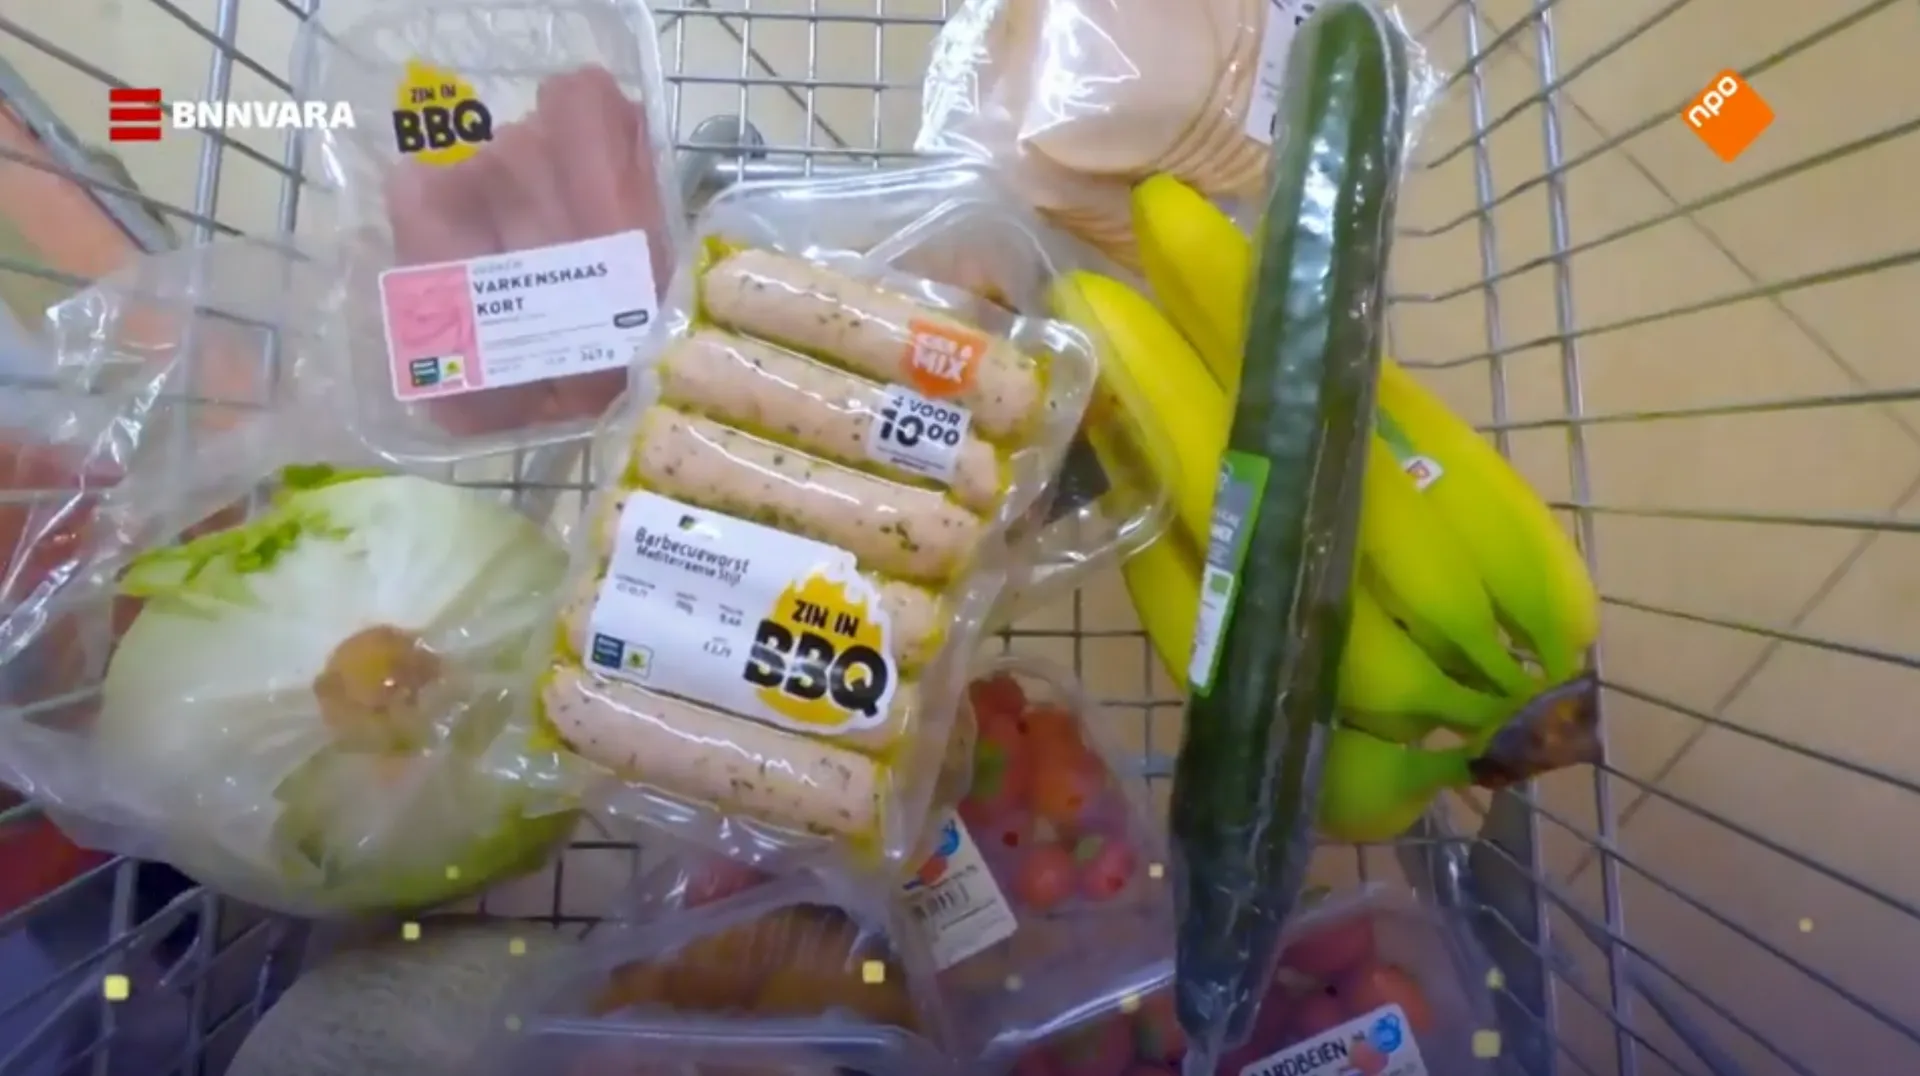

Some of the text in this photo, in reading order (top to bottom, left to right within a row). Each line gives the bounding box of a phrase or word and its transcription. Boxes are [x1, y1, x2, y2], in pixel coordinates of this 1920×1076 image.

[410, 83, 457, 102] ZIN IN
[393, 99, 494, 153] BBQ
[473, 262, 608, 295] VARKENSHAAS
[477, 297, 525, 316] KORT
[909, 400, 961, 426] VOOR
[634, 526, 750, 574] Barbecueworst
[791, 599, 860, 638] ZIN IN
[742, 619, 889, 718] BBQ
[1250, 1037, 1348, 1076] RDBEIEN
